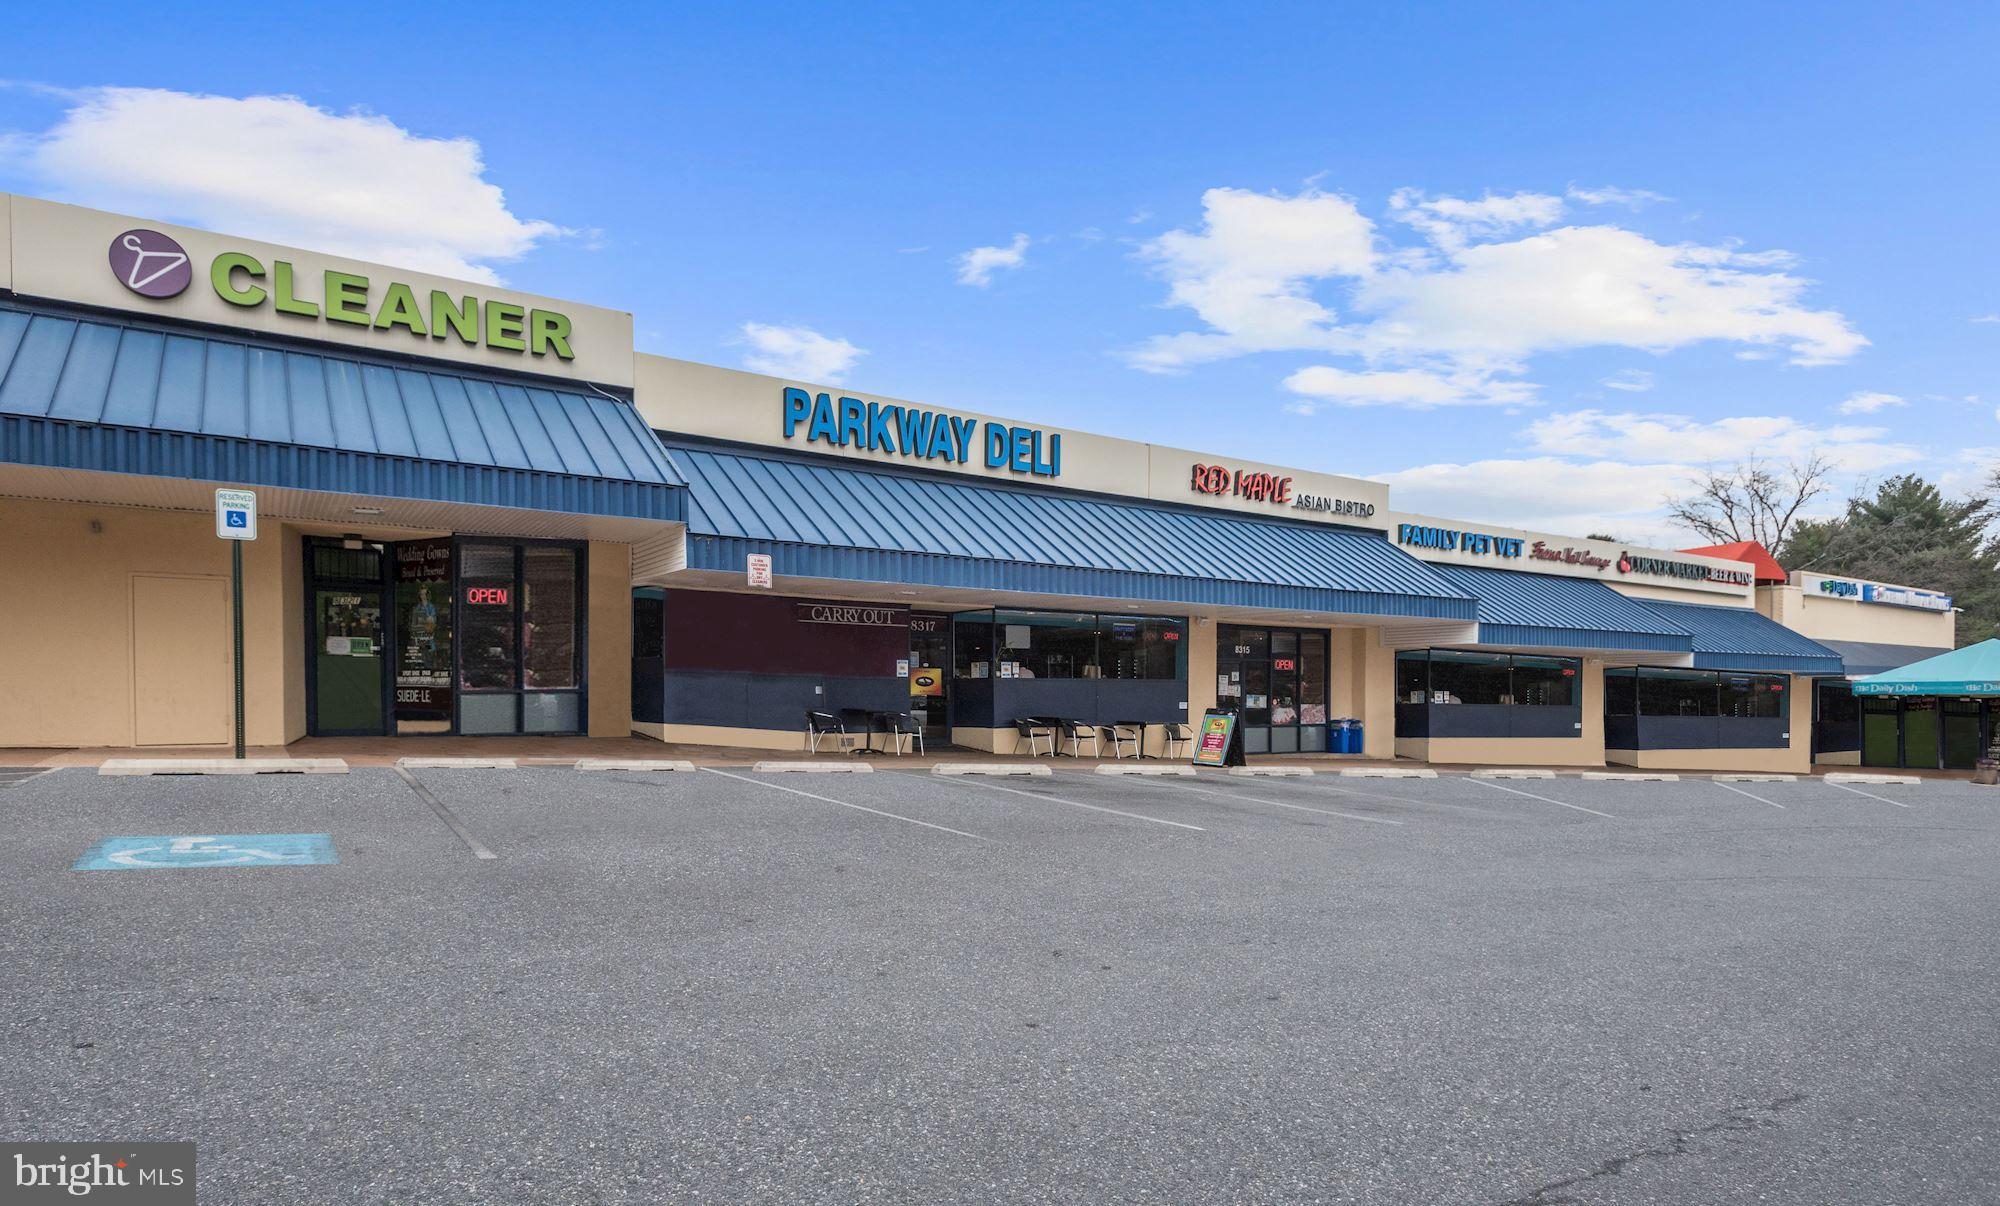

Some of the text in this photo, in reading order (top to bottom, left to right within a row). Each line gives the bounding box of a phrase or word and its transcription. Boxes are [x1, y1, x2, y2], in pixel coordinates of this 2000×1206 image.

[210, 252, 575, 359] CLEANER
[783, 387, 1061, 477] PARKWAY DELI
[1191, 463, 1293, 503] RED MAPLE
[219, 493, 253, 501] RESERVED
[223, 501, 250, 509] PARKING
[1296, 494, 1375, 517] ASIAN BISTRO
[1398, 524, 1525, 558] FAMILY PET VET
[397, 544, 450, 564] Wedding Gowns
[1630, 556, 1670, 577] CORNER
[1672, 561, 1709, 581] MARKET
[468, 588, 507, 604] OPEN
[811, 606, 895, 625] CARRY OUT
[910, 620, 936, 632] 8317
[1163, 632, 1179, 640] OPEN
[1235, 646, 1251, 654] 8315
[1275, 660, 1294, 670] OPEN
[1870, 683, 1893, 693] Daily
[1896, 683, 1918, 692] Dish
